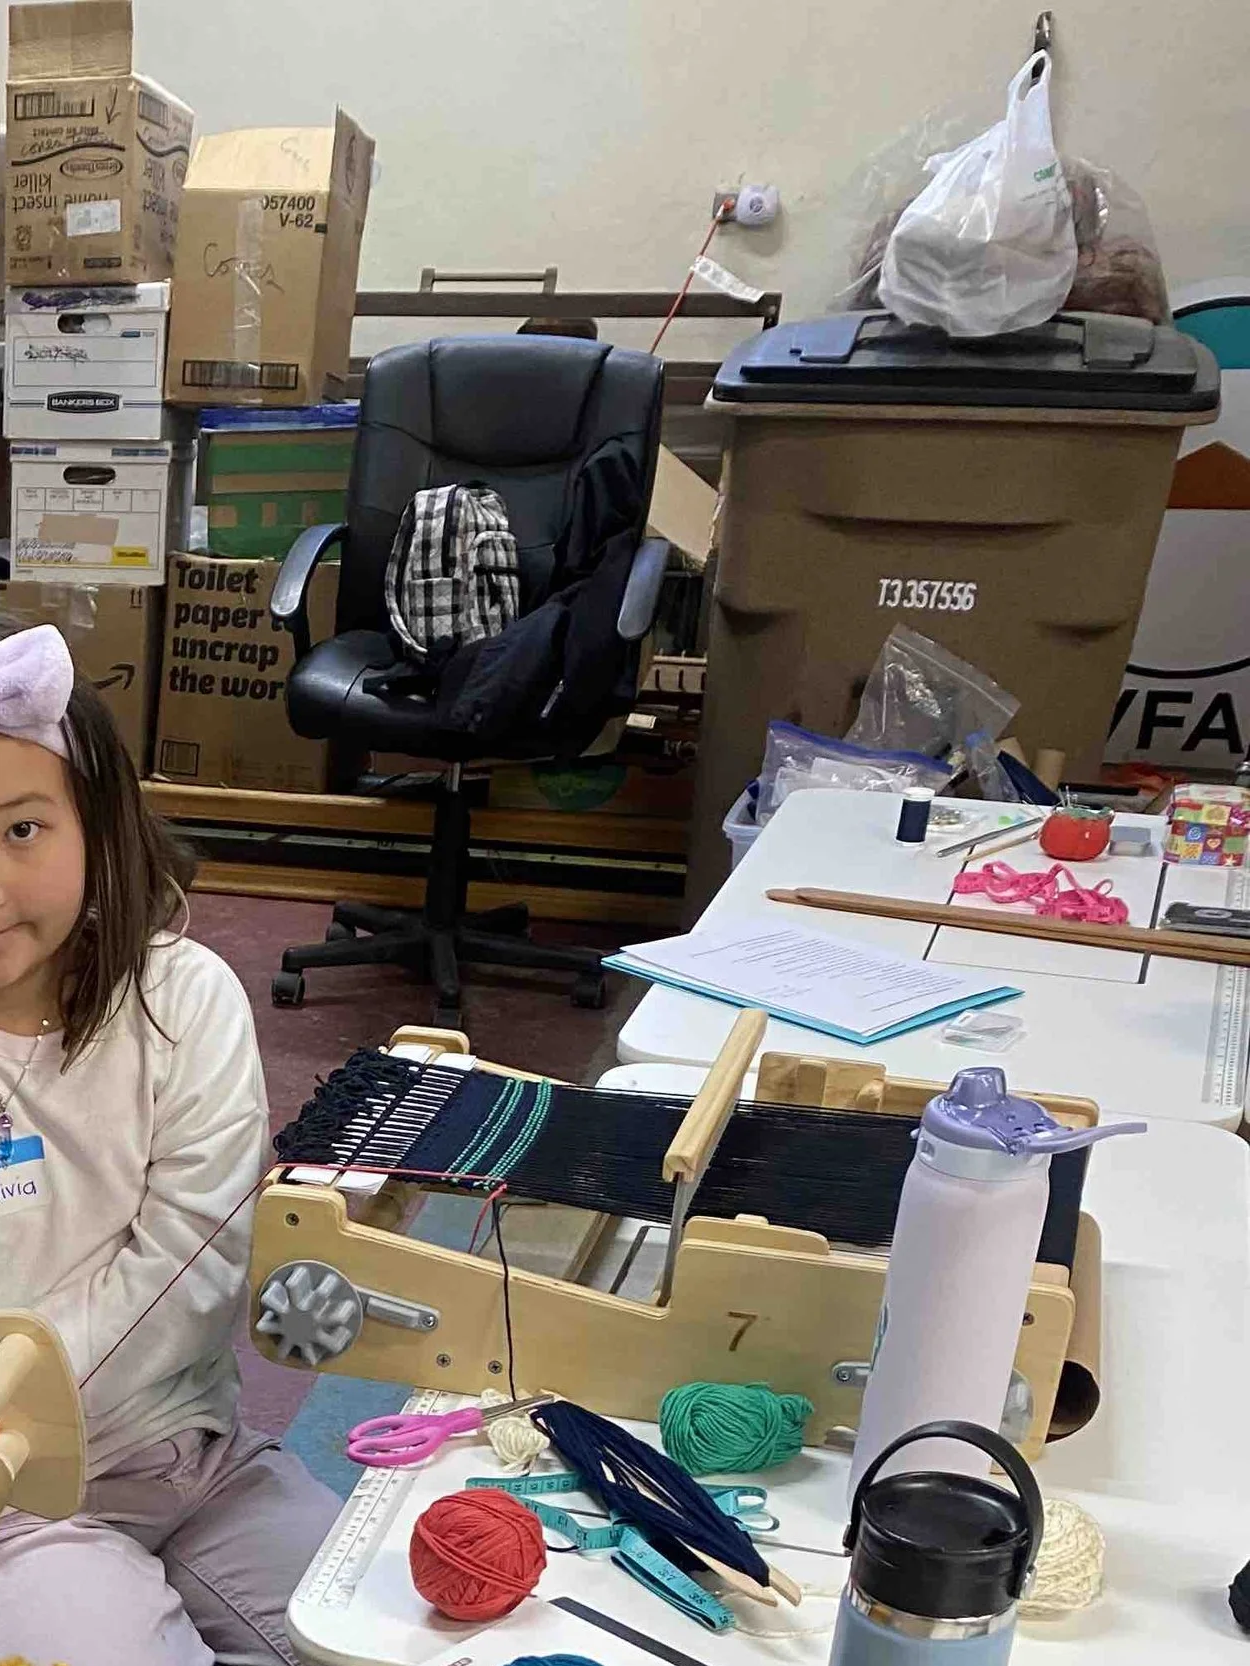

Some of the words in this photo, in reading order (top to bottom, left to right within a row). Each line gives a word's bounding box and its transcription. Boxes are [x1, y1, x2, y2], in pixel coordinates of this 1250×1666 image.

[13, 172, 52, 189] killer
[13, 193, 58, 215] insect
[279, 213, 314, 228] V-62
[51, 398, 95, 406] BANKERS
[96, 398, 115, 406] BOX
[175, 559, 259, 594] Toilet
[174, 602, 264, 633] paper
[172, 636, 279, 672] uncrap
[169, 665, 216, 694] the
[221, 675, 285, 700] wor
[1107, 688, 1245, 754] VFA
[727, 1310, 759, 1352] 7
